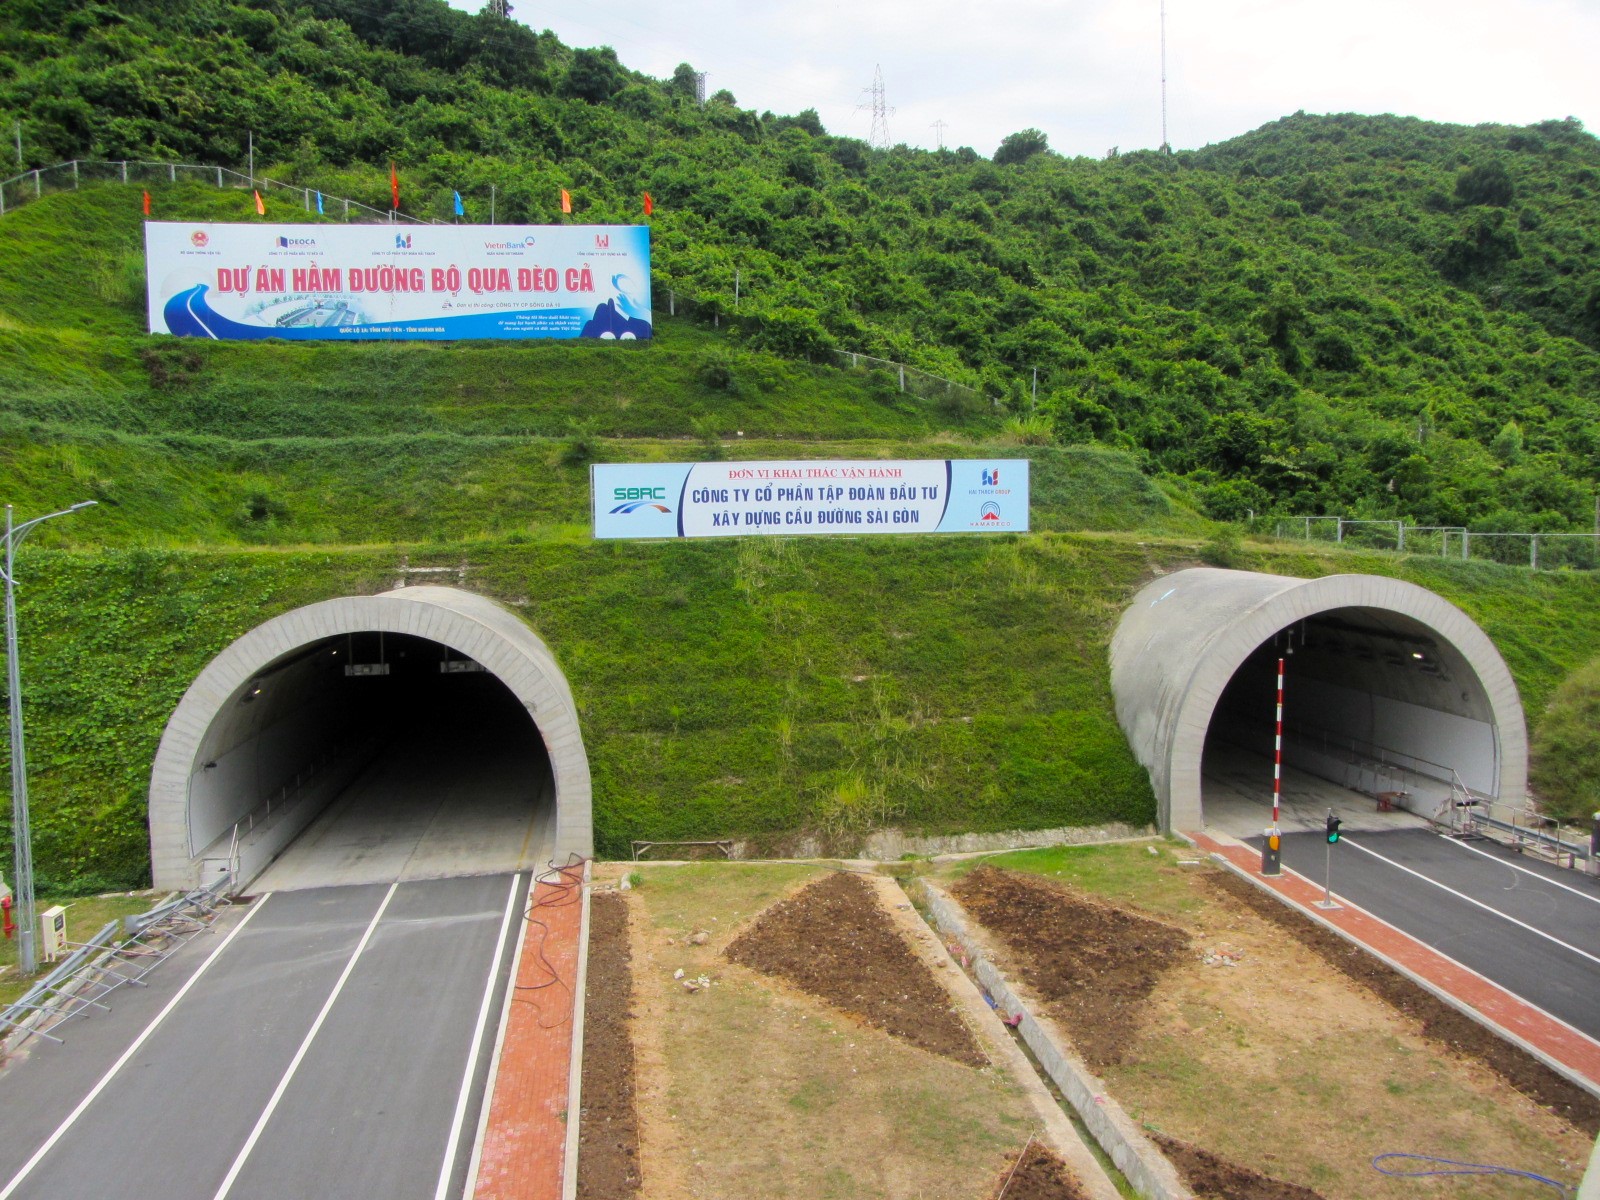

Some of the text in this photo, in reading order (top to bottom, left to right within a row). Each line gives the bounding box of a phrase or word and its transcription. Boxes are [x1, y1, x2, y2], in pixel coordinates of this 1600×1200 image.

[218, 260, 595, 298] DỰ ÁN HẦM ĐƯỜNG BỘ QUA ĐÈO CẢ
[729, 467, 902, 479] ĐƠN VỊ KHAI THÁC VẬN HÀNH
[614, 488, 666, 500] SBRC
[692, 482, 938, 504] CÔNG TY CỔ PHẦN TẬP ĐOÀN ĐẦU TƯ
[712, 506, 919, 528] XÂY DỰNG CẦU ĐƯỜNG SÀI GÒN
